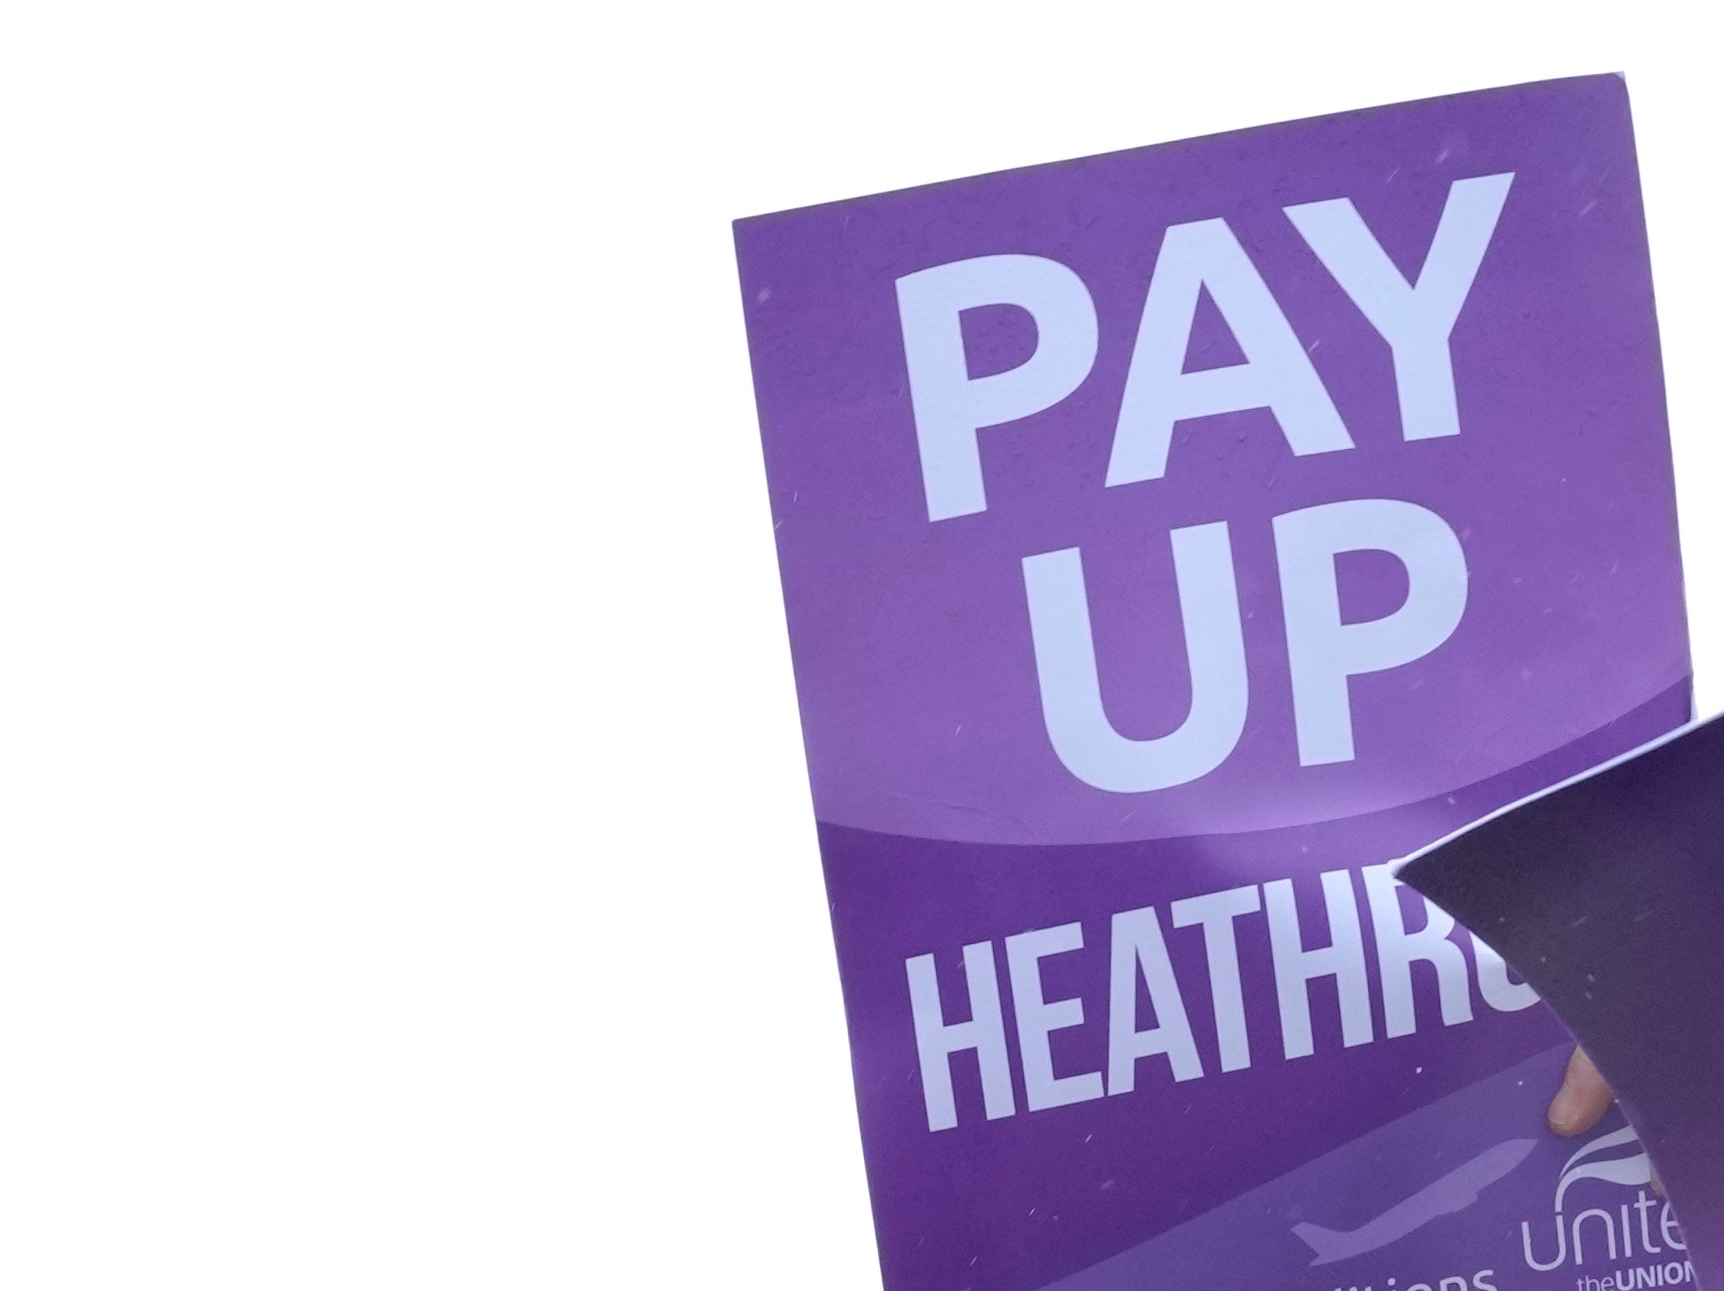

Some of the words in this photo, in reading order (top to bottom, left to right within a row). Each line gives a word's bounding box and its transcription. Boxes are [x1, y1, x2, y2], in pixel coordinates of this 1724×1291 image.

[895, 172, 1516, 522] PAY
[1021, 498, 1469, 793] UP
[906, 864, 1542, 1132] HEATHR
